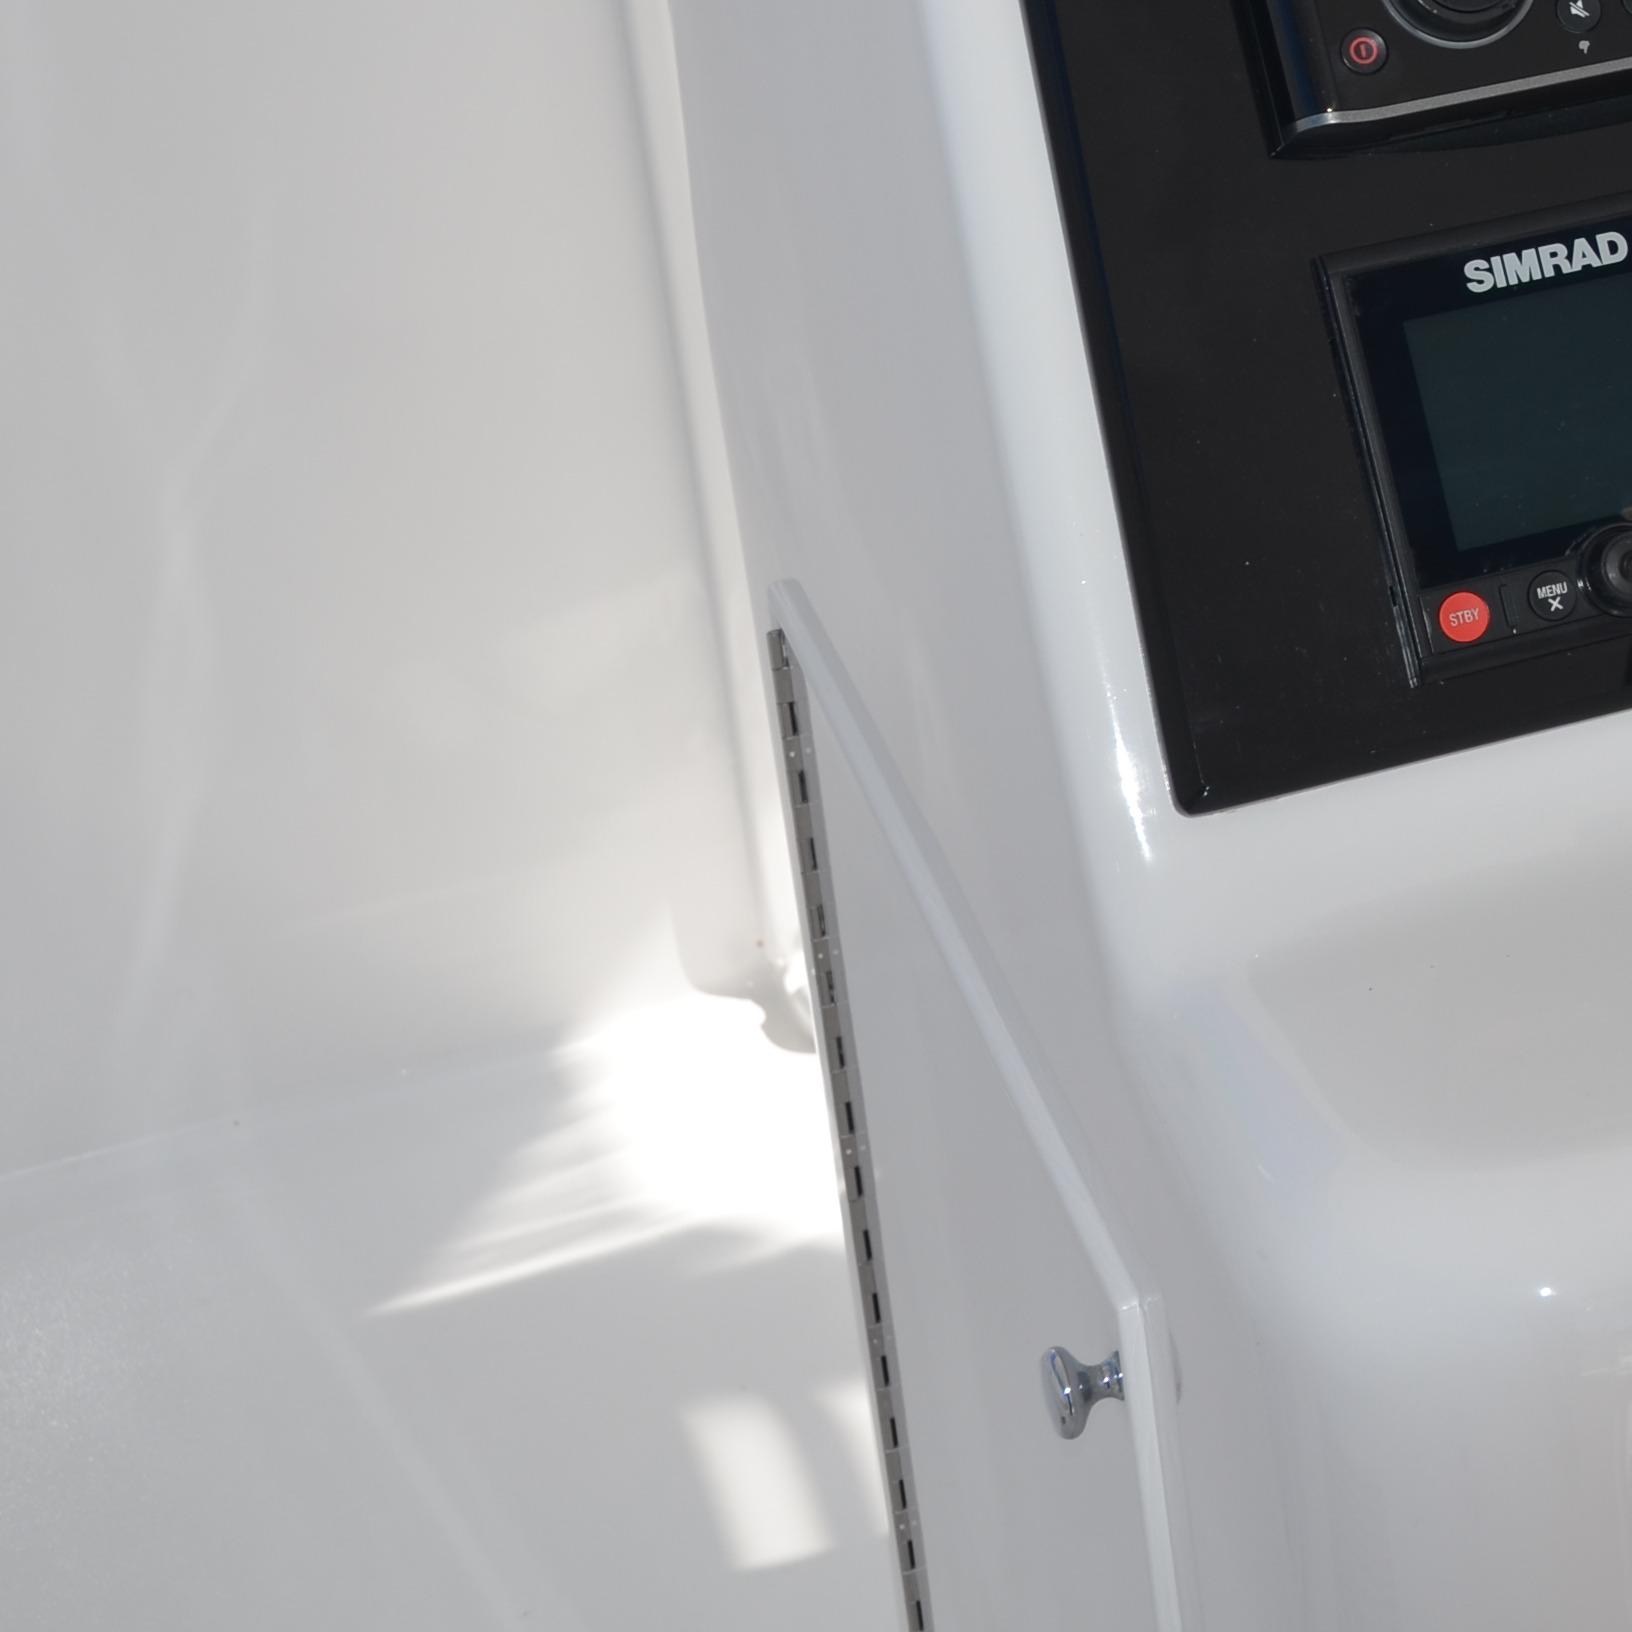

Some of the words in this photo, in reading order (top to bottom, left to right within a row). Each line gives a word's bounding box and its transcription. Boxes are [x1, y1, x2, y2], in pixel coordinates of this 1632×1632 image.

[1463, 231, 1629, 293] SIMRAD
[1536, 581, 1568, 599] MENU
[1449, 607, 1480, 627] STBY
